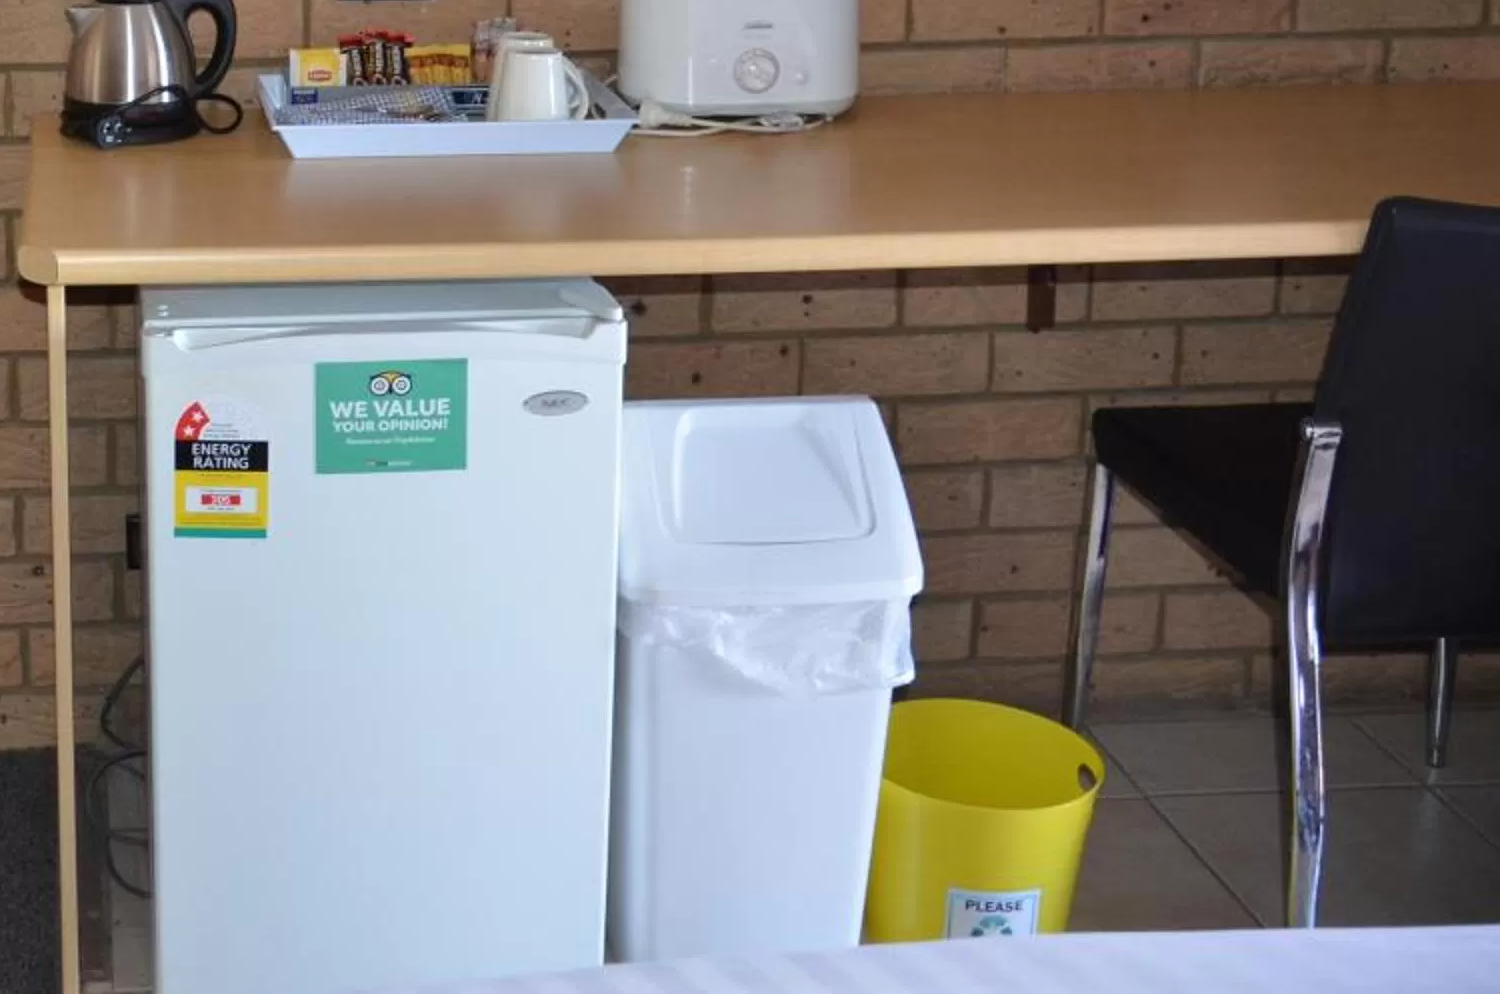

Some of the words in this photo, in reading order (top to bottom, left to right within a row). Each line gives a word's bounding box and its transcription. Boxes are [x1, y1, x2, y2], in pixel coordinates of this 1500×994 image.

[329, 401, 369, 419] WE
[372, 397, 452, 418] VALUE
[332, 420, 375, 433] YOUR
[378, 417, 449, 432] OPINION!
[191, 443, 252, 457] ENERGY
[193, 456, 250, 470] RATING
[964, 899, 1024, 913] PLEASE
